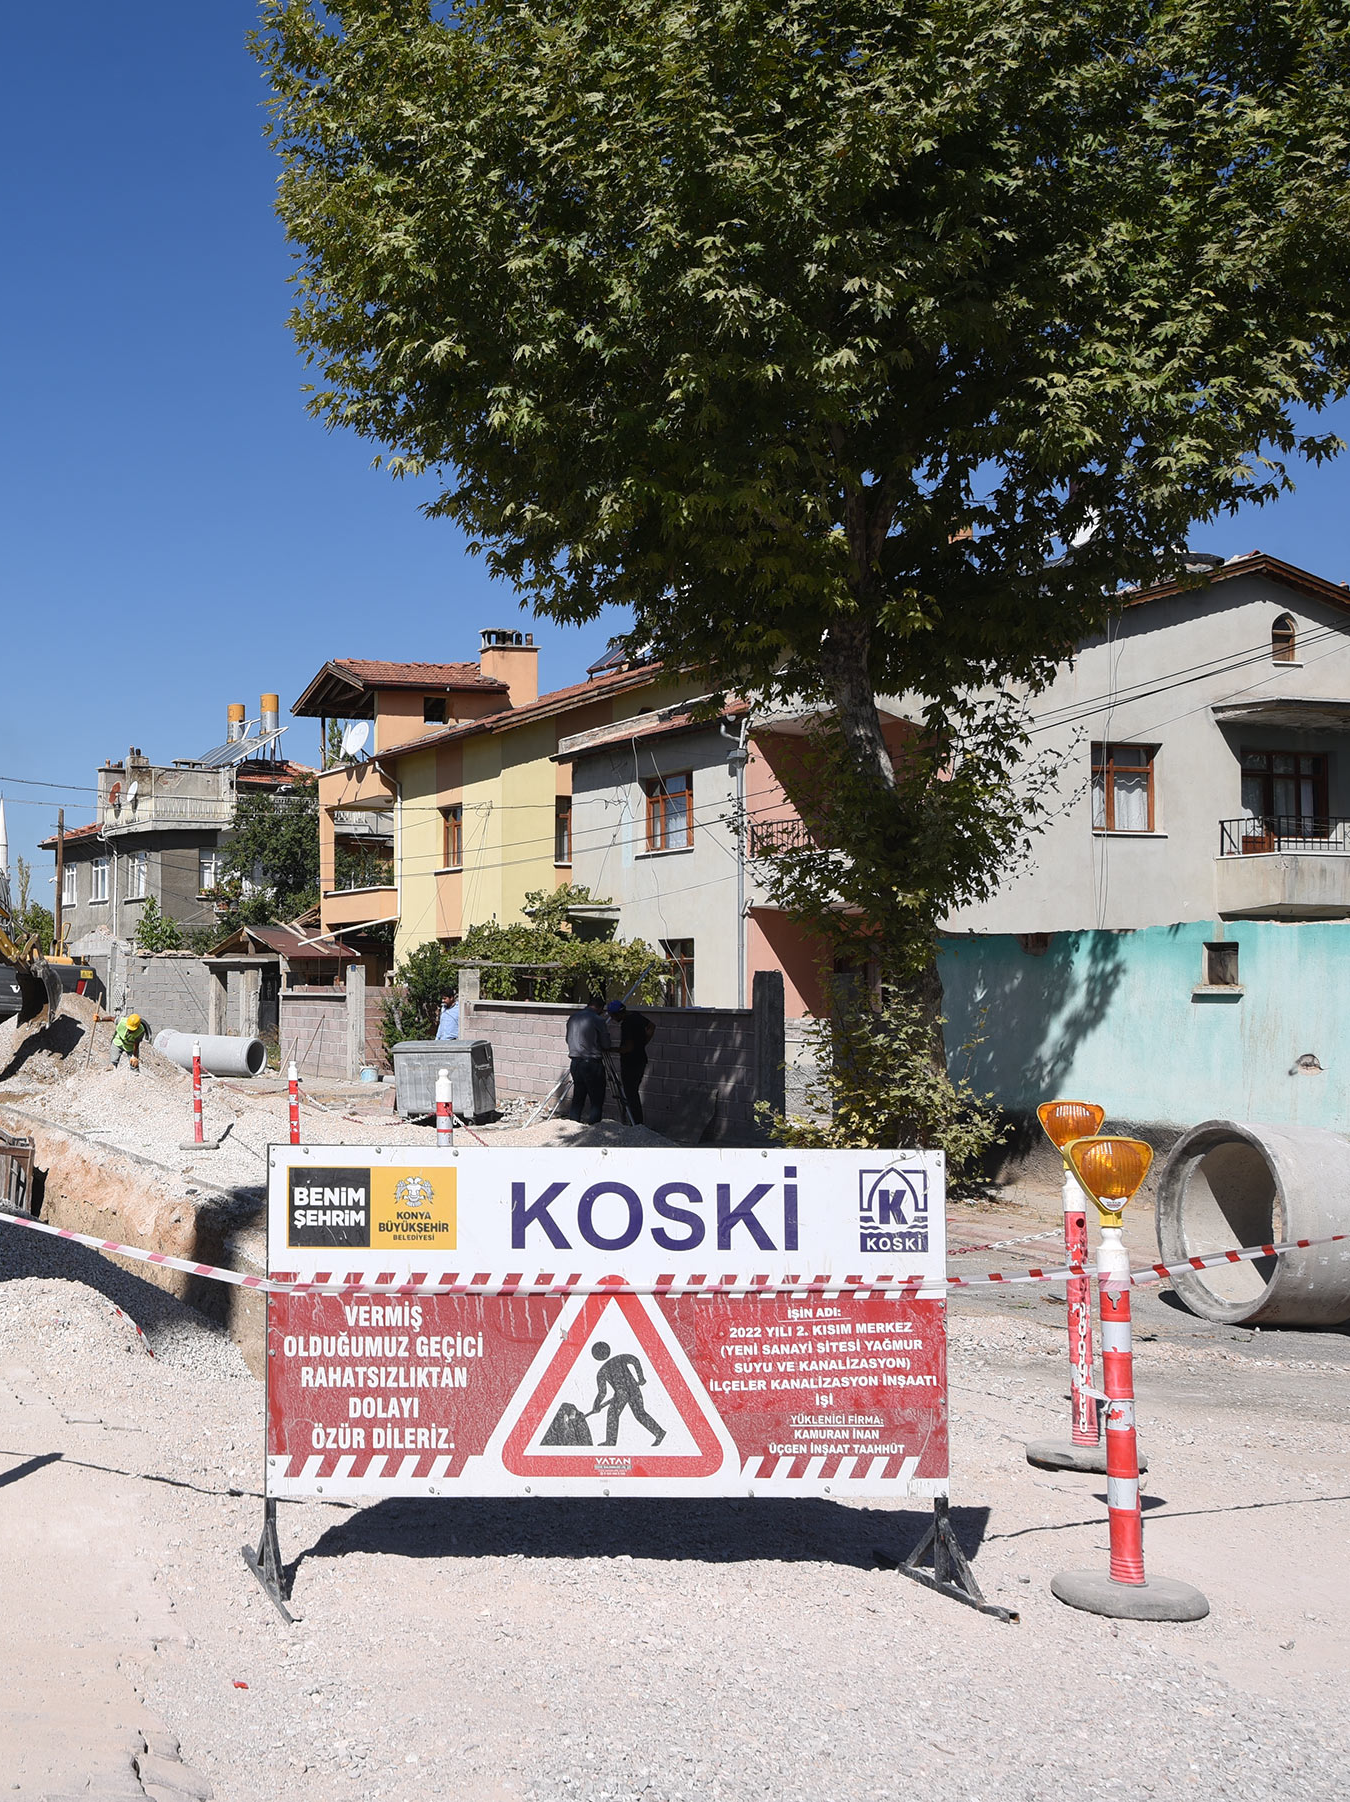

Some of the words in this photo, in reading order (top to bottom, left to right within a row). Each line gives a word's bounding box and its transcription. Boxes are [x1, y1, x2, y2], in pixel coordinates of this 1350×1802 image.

[294, 1187, 365, 1206] BENİM
[396, 1211, 432, 1220] KONYA
[511, 1165, 799, 1251] KOSKİ
[293, 1209, 366, 1229] ŞEHRİM
[378, 1220, 449, 1234] BÜYÜKŞEHİR
[393, 1233, 435, 1241] BELEDİYESİ
[866, 1234, 922, 1251] KOSKİ
[345, 1301, 423, 1332] VERMİŞ
[787, 1306, 813, 1321] İŞİN
[816, 1307, 842, 1317] ADI:
[729, 1327, 762, 1338] 2022
[765, 1326, 793, 1338] YILI
[796, 1326, 809, 1336] 2.
[812, 1323, 852, 1336] KISIM
[855, 1322, 913, 1334] MERKEZ
[283, 1331, 410, 1358] OLDUĞUMUZ
[416, 1331, 484, 1362] GEÇİCİ
[720, 1342, 758, 1358] (YENİ
[762, 1341, 813, 1355] SANAYİ
[816, 1338, 861, 1354] SİTESİ
[864, 1338, 923, 1351] YAĞMUR
[734, 1361, 772, 1374] SUYU
[776, 1361, 795, 1372] VE
[799, 1356, 911, 1372] KANALİZASYON)
[301, 1366, 468, 1388] RAHATSIZLIKTAN
[709, 1378, 767, 1394] İLÇELER
[771, 1375, 878, 1390] KANALİZASYON
[882, 1373, 938, 1388] İNŞAATI
[348, 1397, 419, 1419] DOLAYI
[815, 1392, 834, 1408] İŞİ
[790, 1413, 845, 1425] YÜKLENİCİ
[849, 1414, 884, 1425] FİRMA:
[311, 1423, 365, 1449] ÖZÜR
[372, 1423, 455, 1449] DİLERİZ.
[794, 1429, 850, 1439] KAMURAN
[853, 1428, 880, 1439] İNAN
[769, 1442, 807, 1455] ÜÇGEN
[810, 1442, 850, 1455] İNŞAAT
[853, 1442, 905, 1454] TAAHHÜT
[595, 1457, 631, 1465] VATAN
